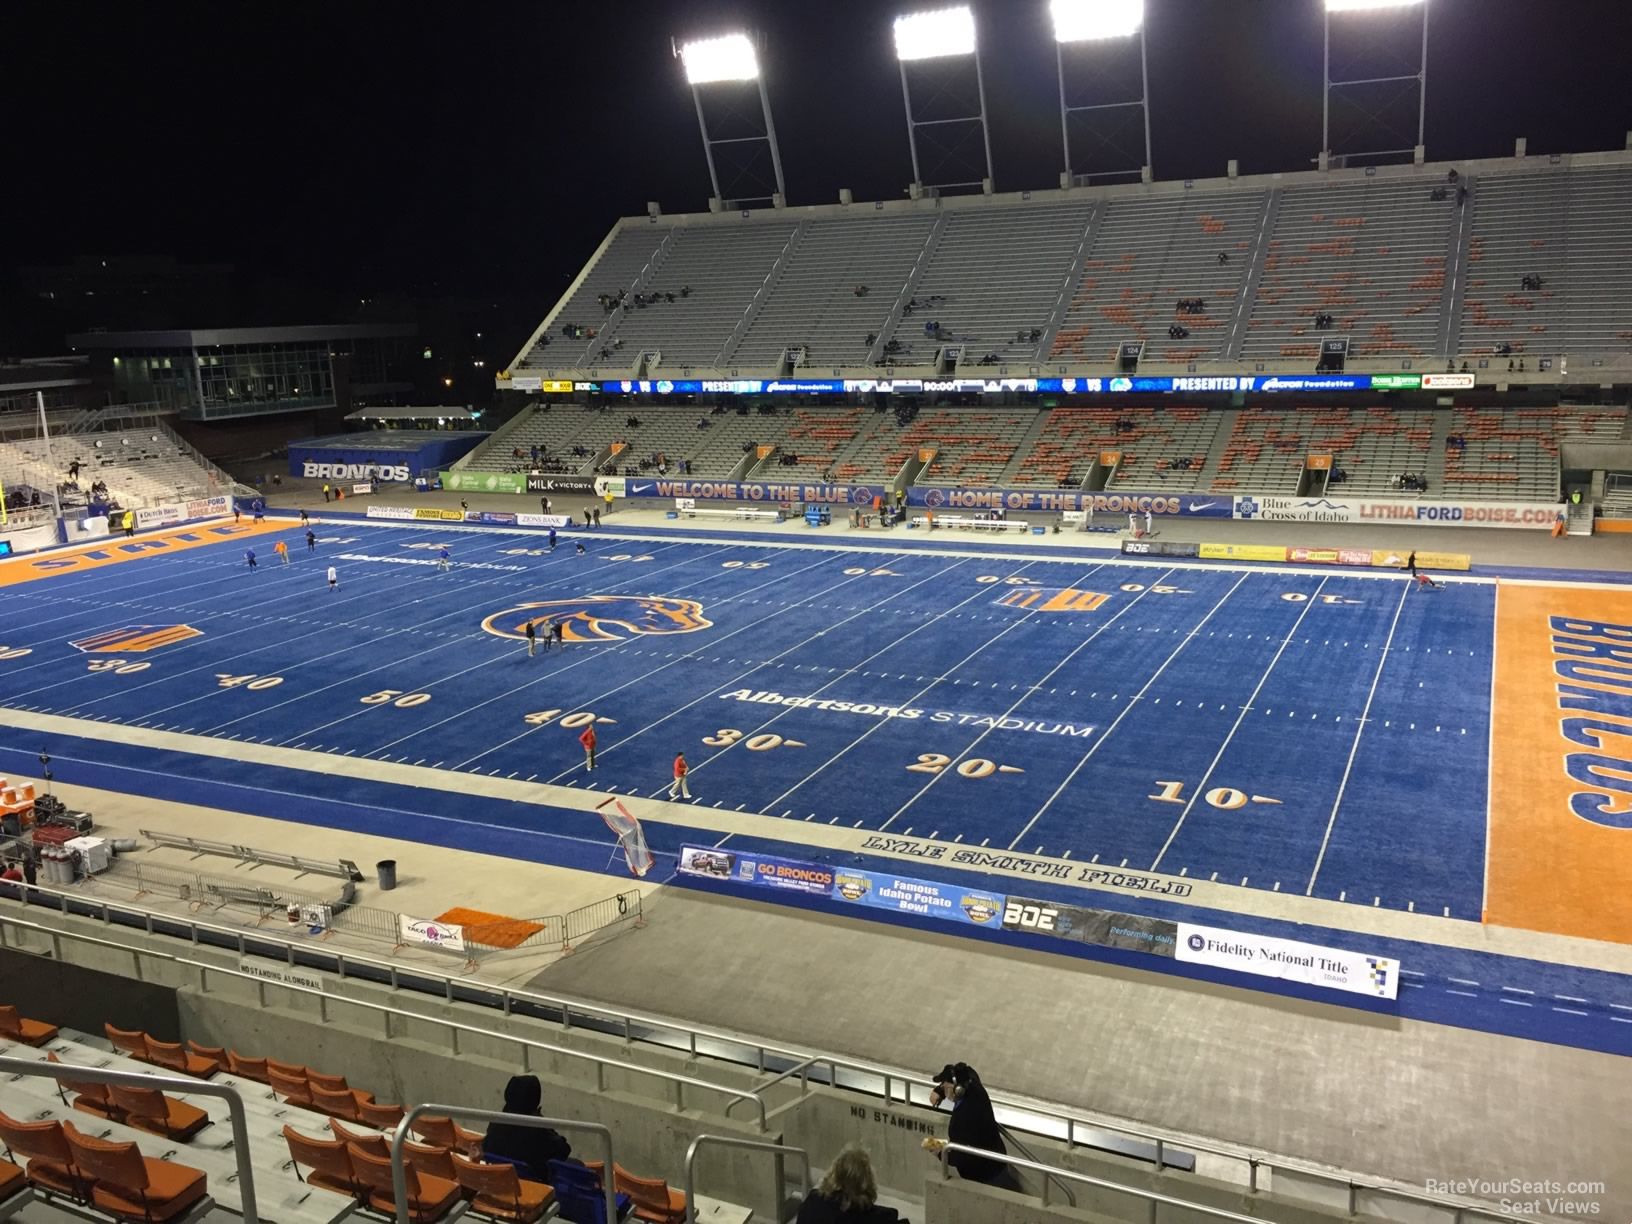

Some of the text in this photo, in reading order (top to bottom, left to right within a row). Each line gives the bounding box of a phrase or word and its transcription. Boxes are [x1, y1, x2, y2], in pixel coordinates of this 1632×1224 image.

[1087, 379, 1102, 391] VS
[1172, 377, 1255, 391] PRESENTED BY
[302, 462, 410, 482] BRONCOS
[528, 479, 588, 490] MILK VICTORY
[656, 481, 848, 503] WELCOME TO THE BLUE
[949, 490, 1180, 513] HOME OF THE BRONCOS
[1262, 497, 1292, 509] Blue
[522, 515, 540, 523] ZIONS
[542, 516, 561, 524] BANK
[1261, 509, 1350, 523] Cross of Idaho
[1360, 503, 1562, 525] LITHIAFORDBOISE.COM
[31, 524, 252, 570] STATE
[88, 659, 151, 674] 30
[215, 674, 284, 690] 40
[360, 689, 432, 708] 50
[524, 709, 597, 728] 40
[718, 688, 1094, 738] Albertsons STADIUM
[701, 728, 783, 751] 30
[905, 753, 997, 778] 20
[1147, 780, 1249, 810] 10
[757, 863, 775, 875] GO
[777, 867, 832, 884] BRONCOS
[861, 836, 1193, 898] LYLE SMITH FIELD
[879, 887, 952, 908] Idaho Potato
[893, 880, 939, 896] Famous
[899, 900, 929, 913] Bowl
[1002, 902, 1058, 930] BOE
[407, 925, 426, 934] TACO
[1207, 939, 1349, 975] Fidelity National Title
[1324, 973, 1348, 984] IDAHO
[850, 1105, 935, 1137] NO STANDING
